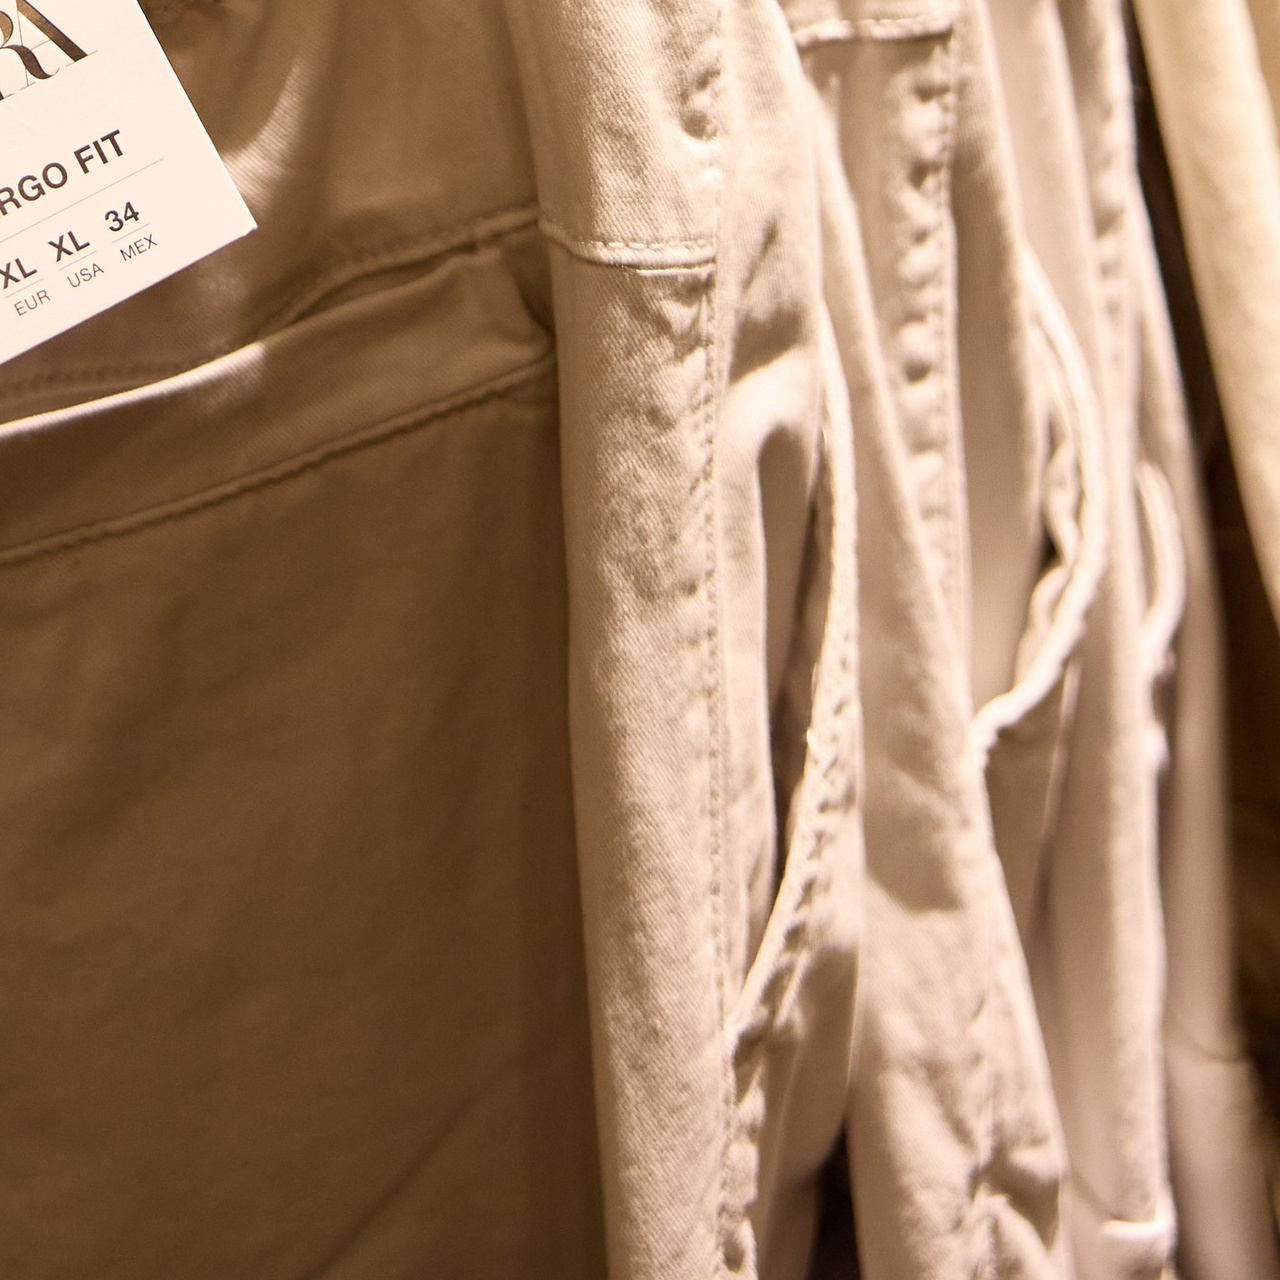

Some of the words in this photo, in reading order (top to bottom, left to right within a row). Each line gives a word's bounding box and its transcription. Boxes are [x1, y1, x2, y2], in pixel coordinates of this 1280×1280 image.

[74, 130, 127, 174] FIT
[48, 230, 91, 263] XL
[104, 201, 141, 233] 34
[14, 289, 51, 316] EUR
[67, 262, 105, 289] USA
[119, 234, 158, 262] MEX
